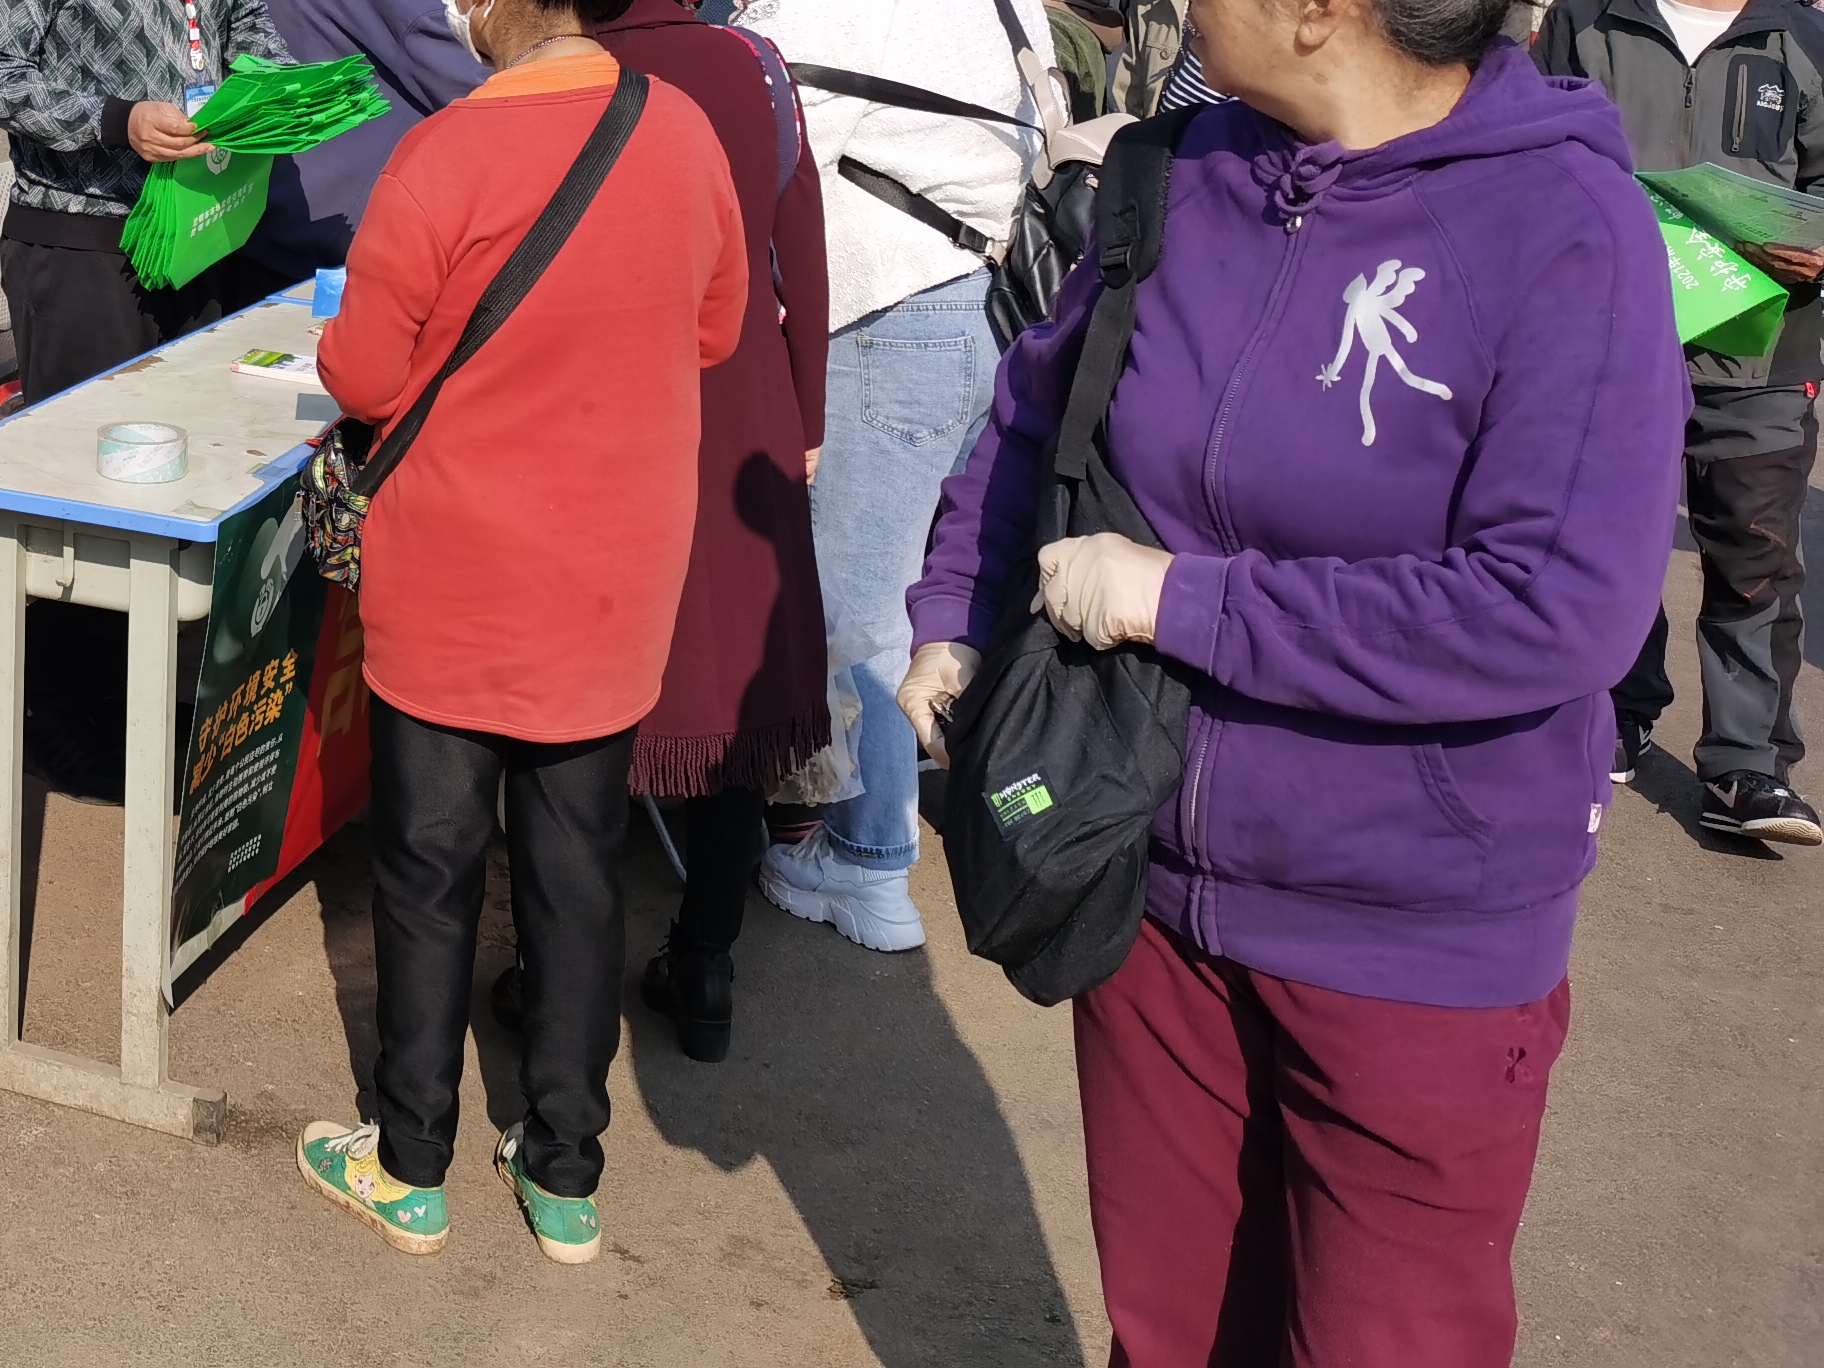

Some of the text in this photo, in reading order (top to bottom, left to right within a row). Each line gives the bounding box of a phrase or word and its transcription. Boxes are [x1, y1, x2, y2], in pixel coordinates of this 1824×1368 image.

[198, 647, 299, 753] 守护环境安全
